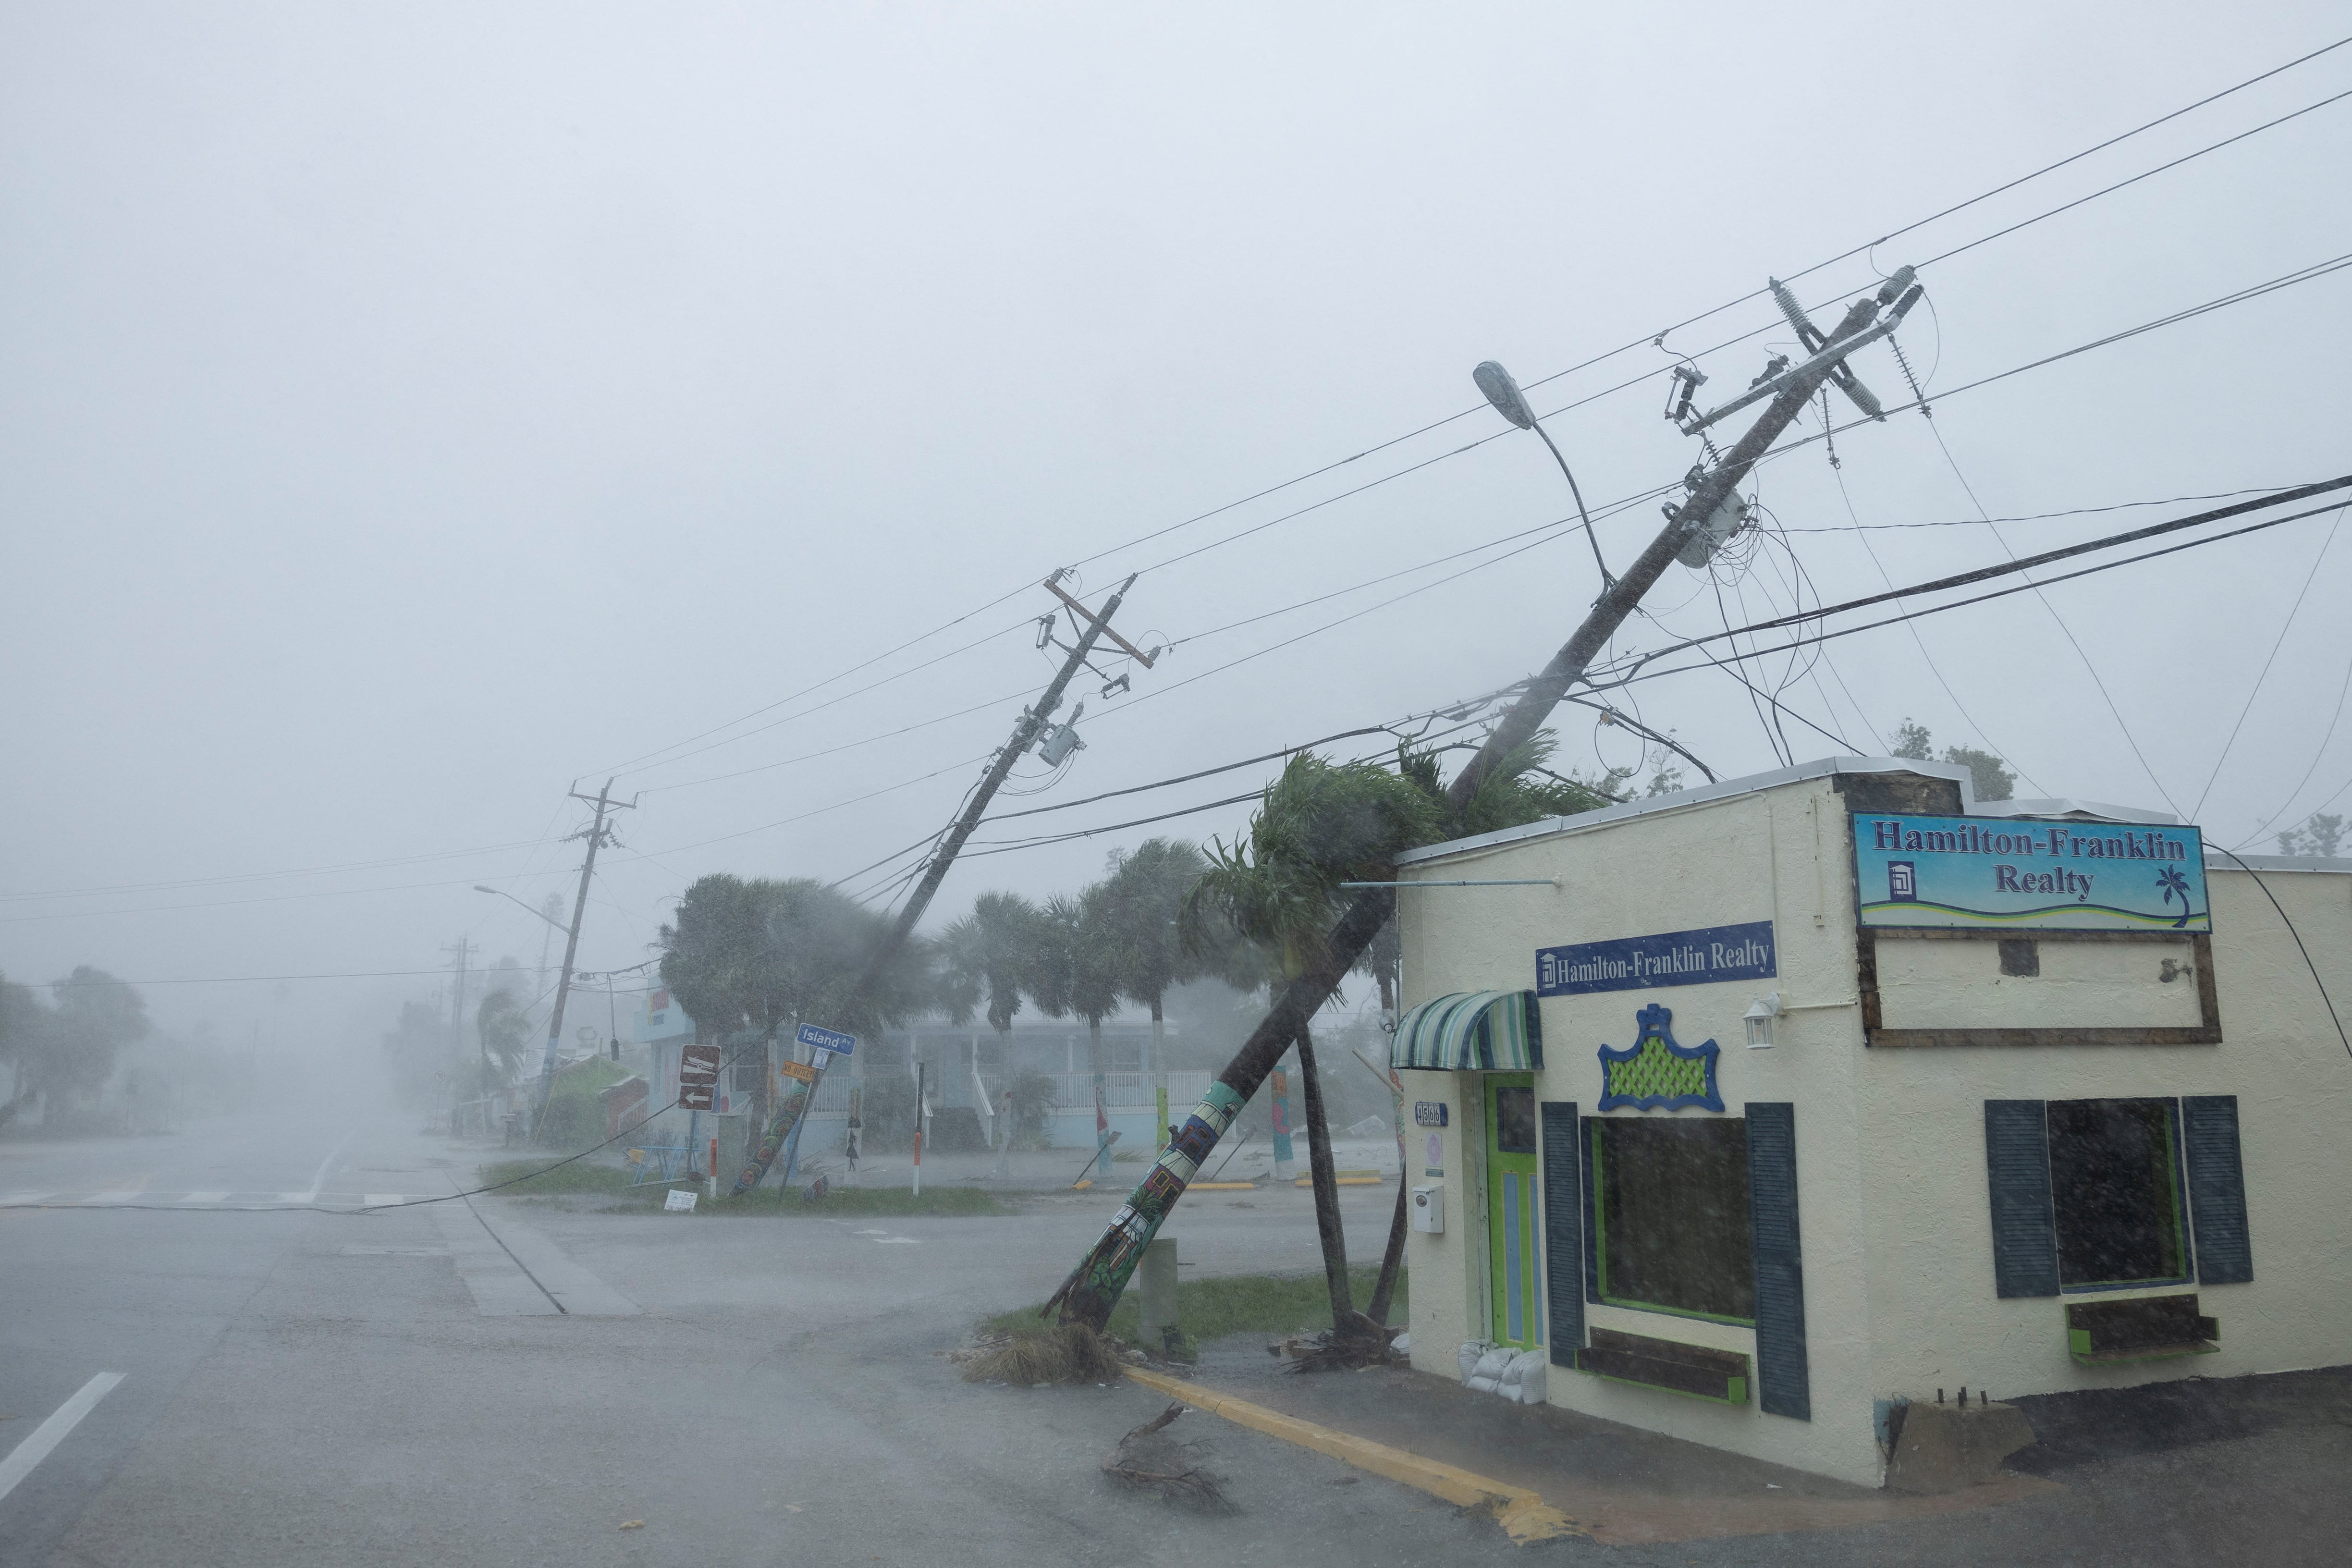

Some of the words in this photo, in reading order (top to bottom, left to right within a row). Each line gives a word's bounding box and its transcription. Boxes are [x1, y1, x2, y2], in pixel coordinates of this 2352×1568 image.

[1871, 821, 2187, 860] Hamilton-Franklin
[1993, 864, 2095, 902] Realty
[1557, 945, 1705, 984] Hamilton-Franklin
[1710, 939, 1770, 972] Realty
[803, 1029, 840, 1048] Island
[783, 1064, 791, 1072] NO
[794, 1066, 813, 1078] OUTLET
[1418, 1107, 1440, 1122] 4566
